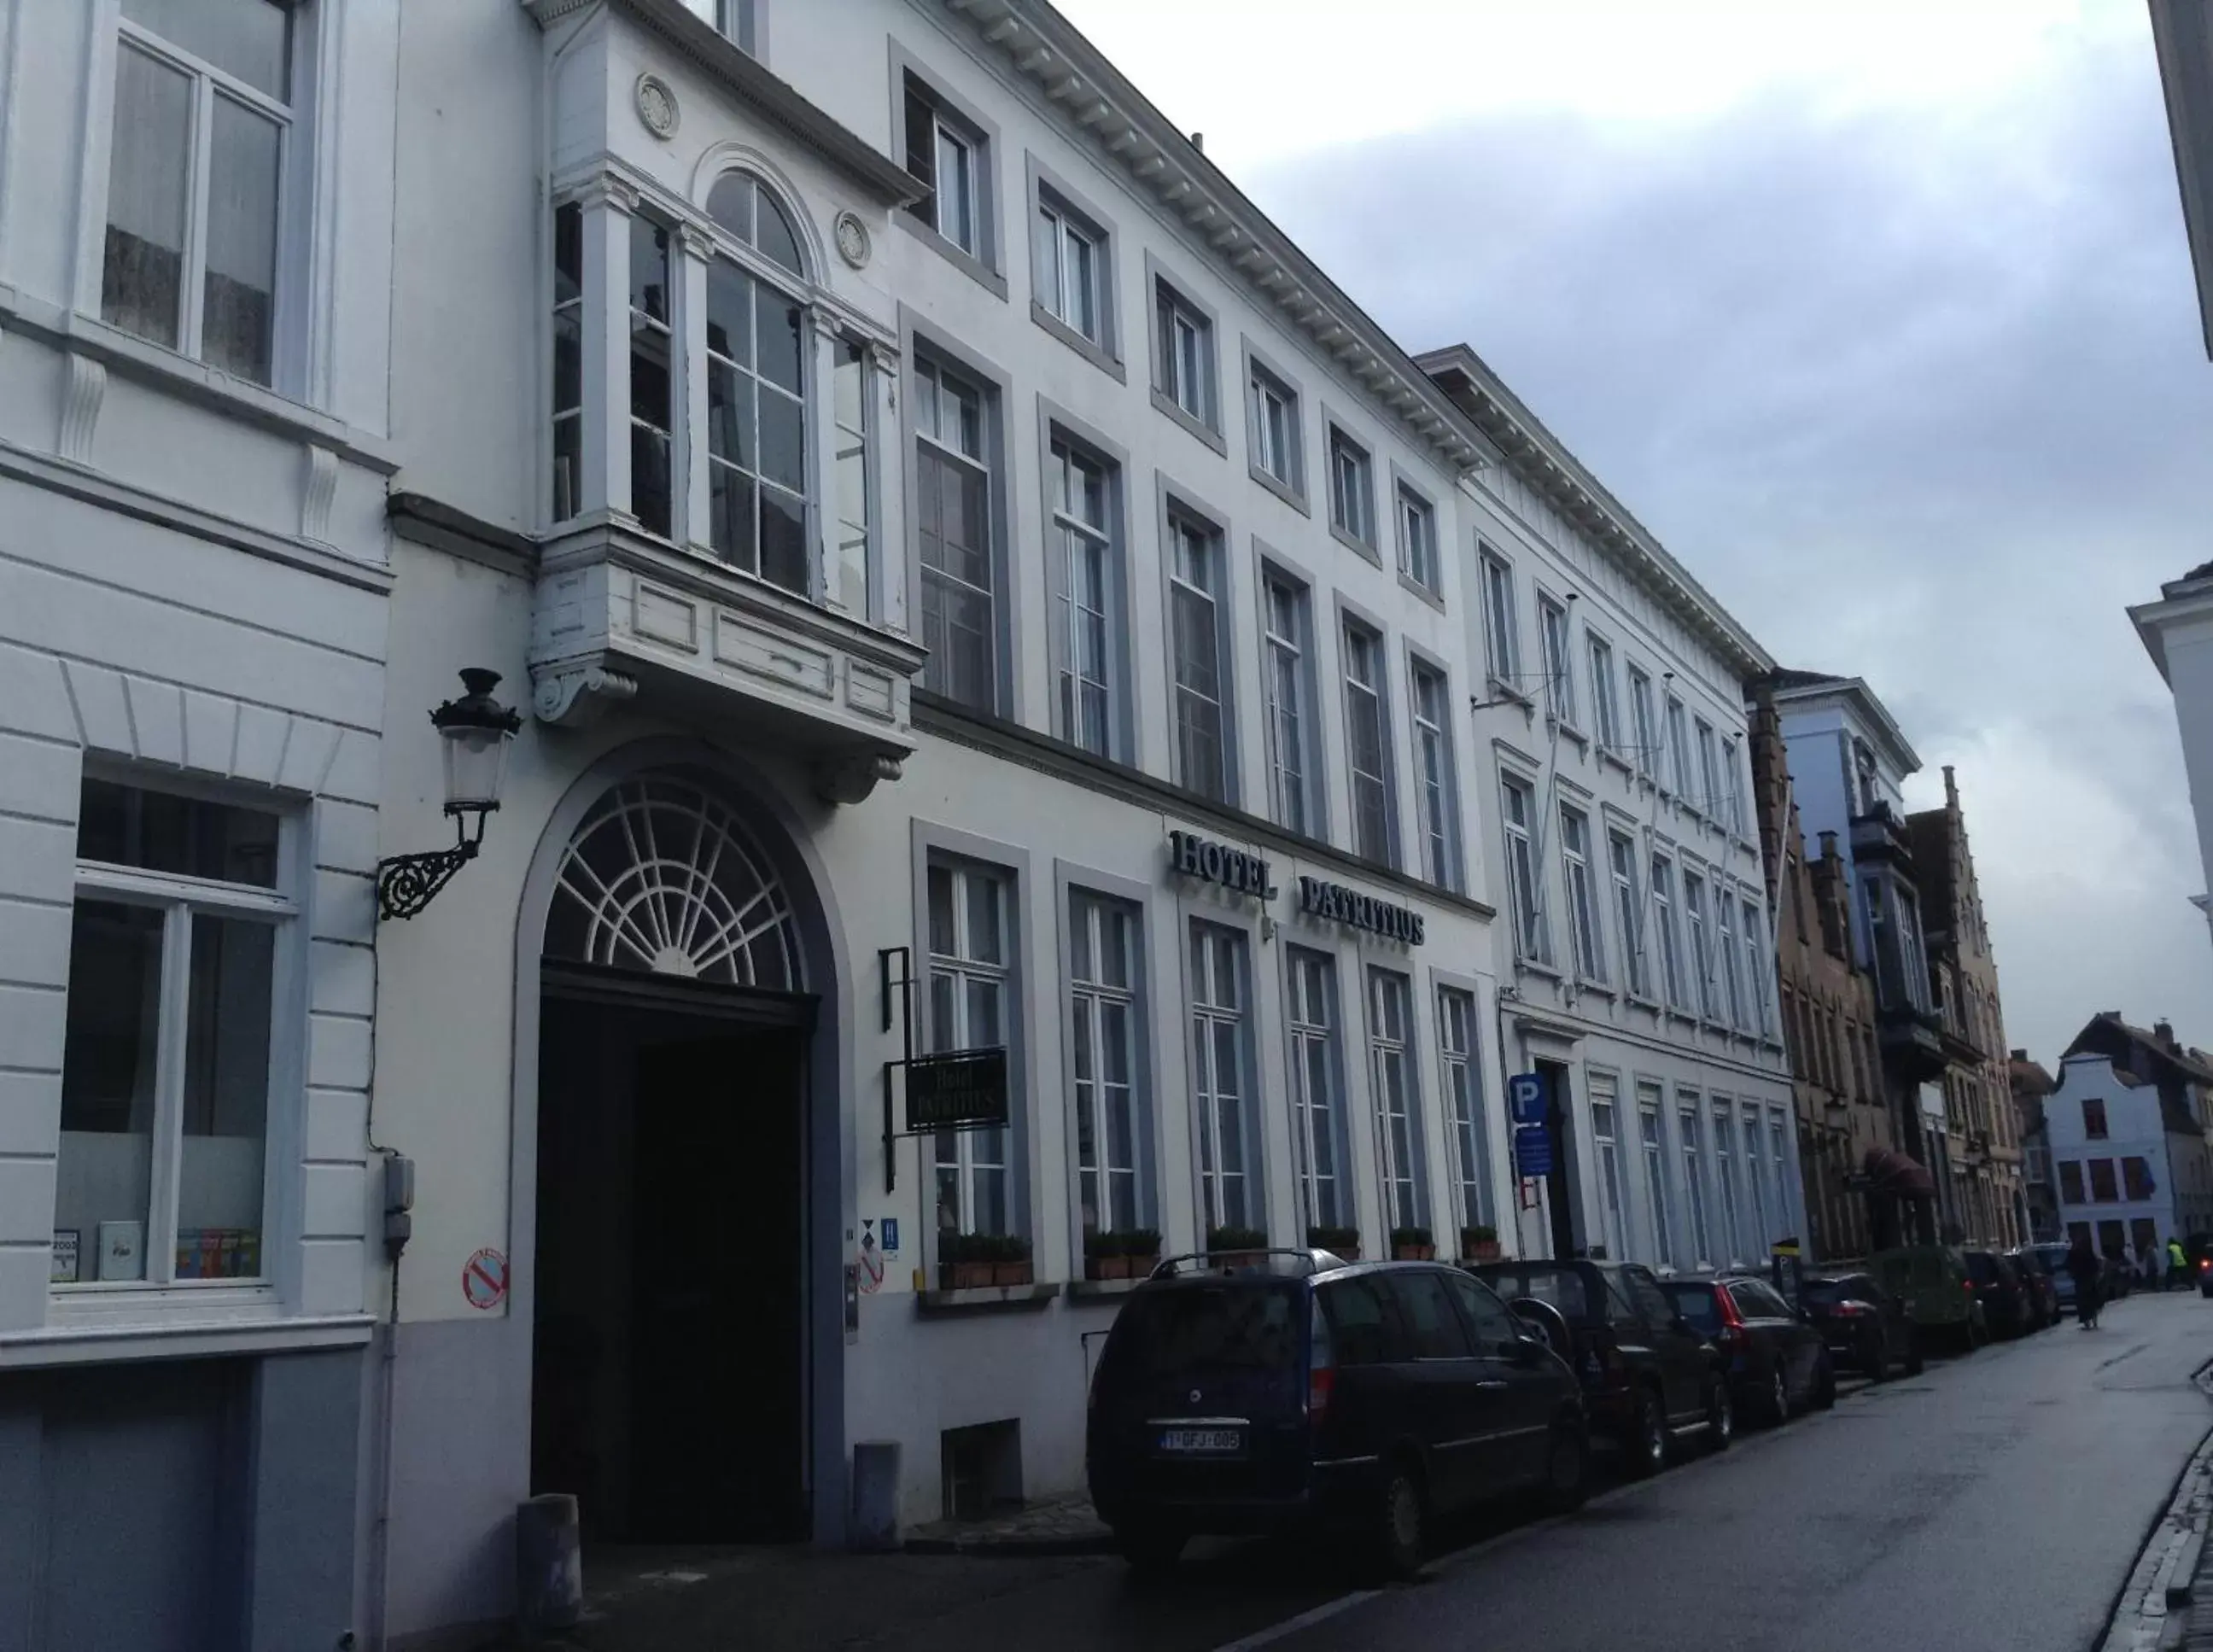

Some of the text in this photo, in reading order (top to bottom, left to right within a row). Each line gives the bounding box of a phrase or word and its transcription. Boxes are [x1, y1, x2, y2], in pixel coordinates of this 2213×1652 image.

[1170, 830, 1424, 945] HOTEL PATRITIUS
[1516, 1082, 1539, 1116] P
